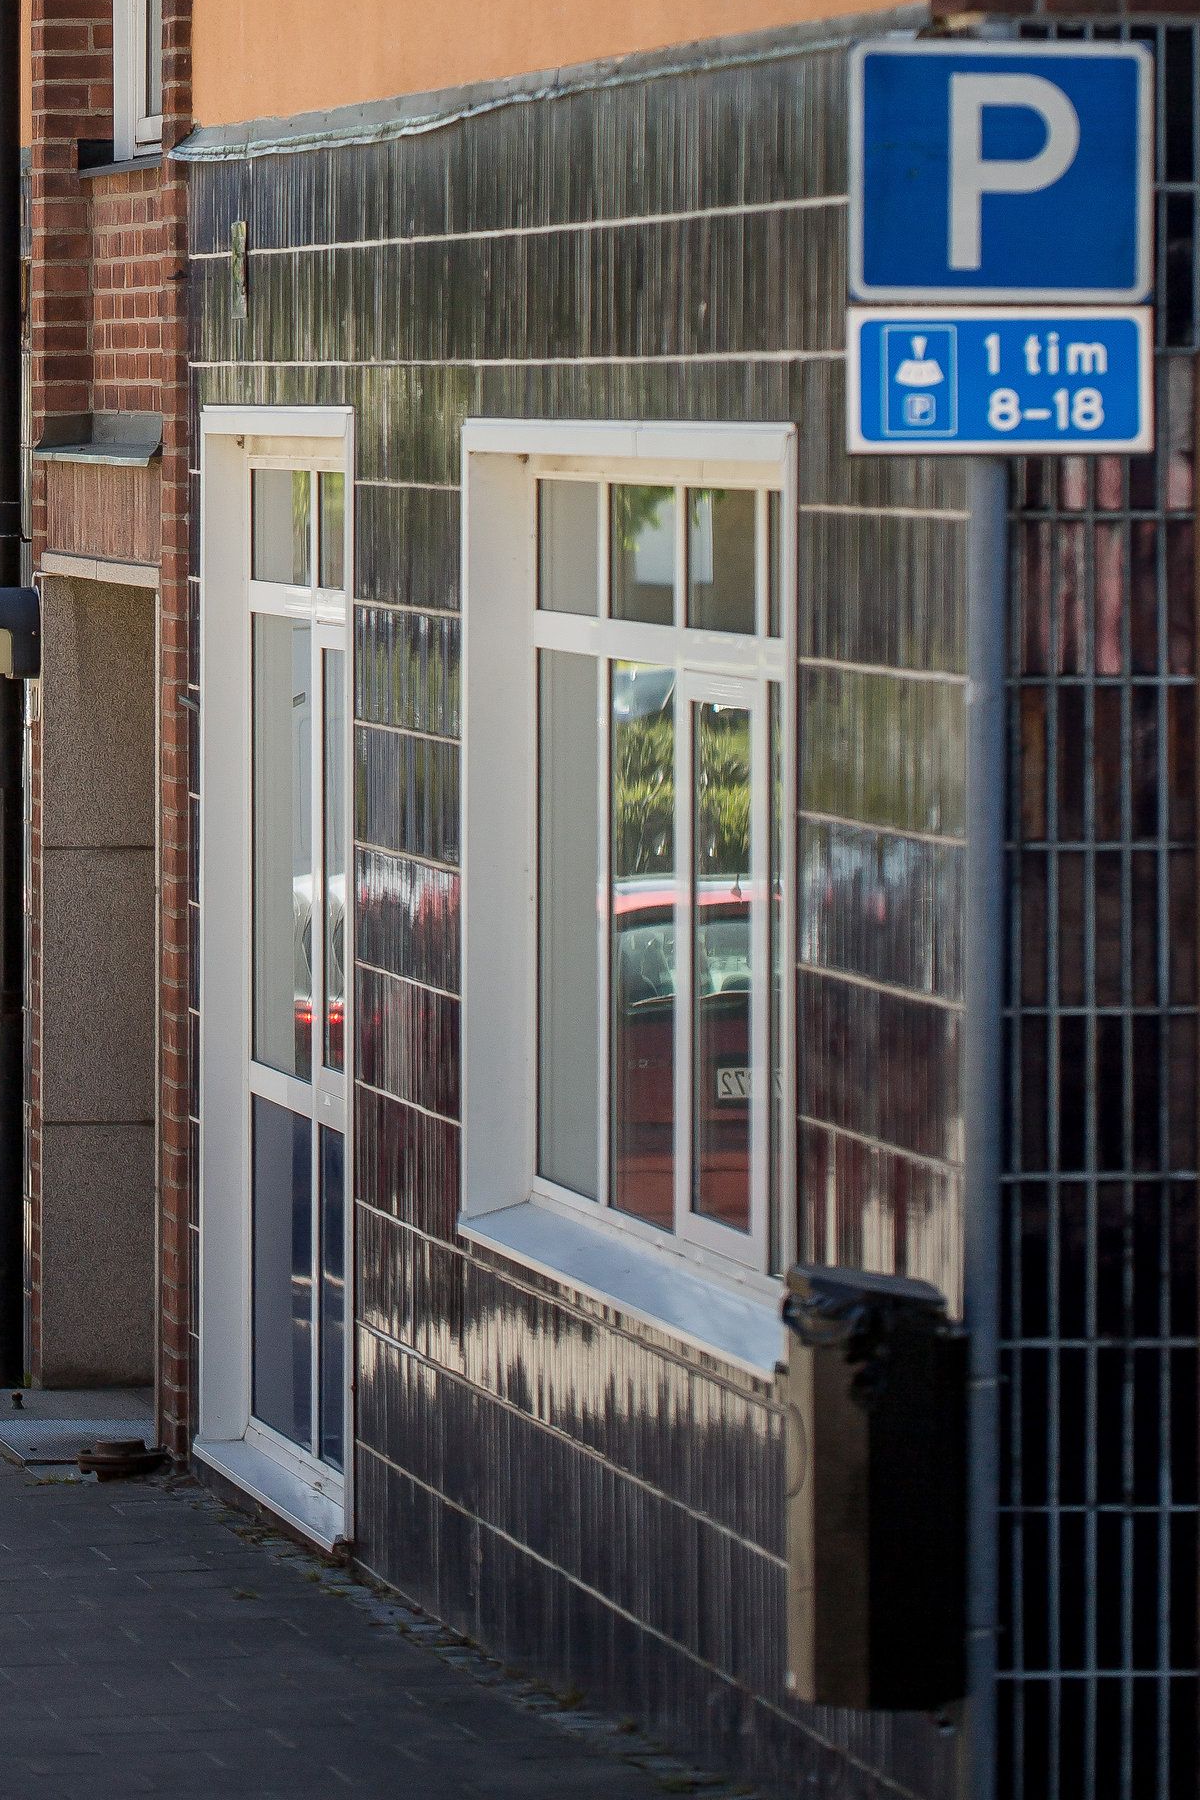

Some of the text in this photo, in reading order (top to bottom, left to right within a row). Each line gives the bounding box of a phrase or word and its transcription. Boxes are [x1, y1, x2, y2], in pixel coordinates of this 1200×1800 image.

[948, 72, 1080, 270] P
[984, 331, 1108, 375] 1 tim
[987, 387, 1105, 432] 8-18
